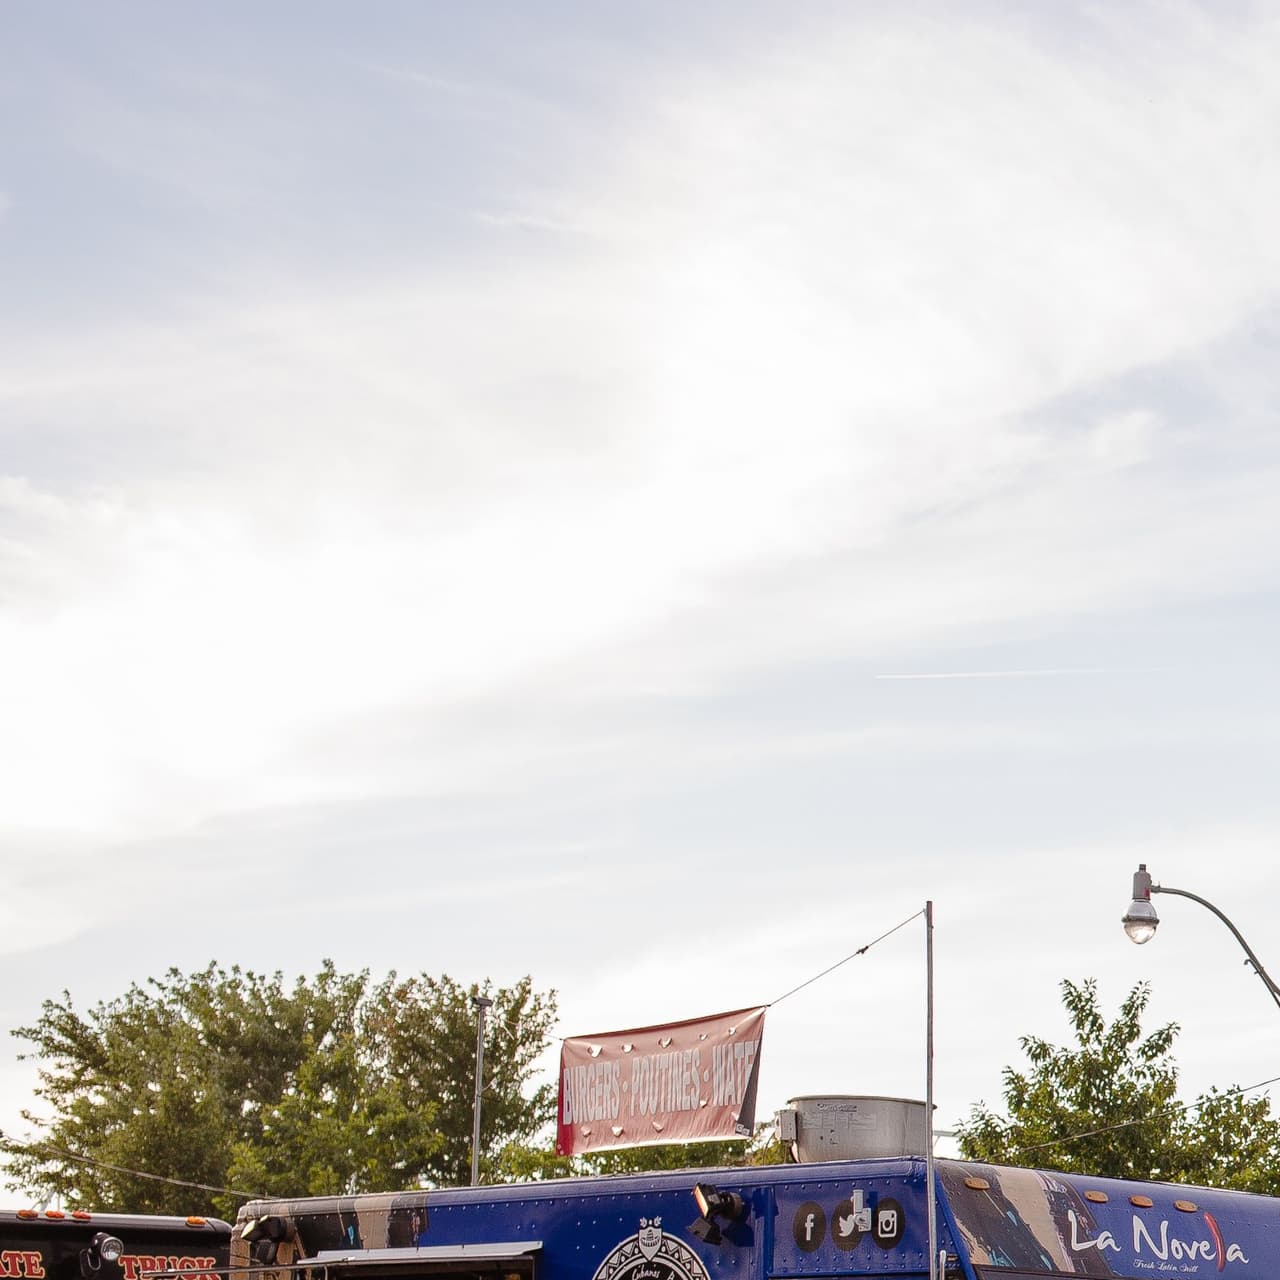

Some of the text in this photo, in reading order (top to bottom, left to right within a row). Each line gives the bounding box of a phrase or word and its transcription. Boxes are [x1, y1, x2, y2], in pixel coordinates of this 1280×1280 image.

[563, 1040, 760, 1125] BURGERS POUTINES WATE
[1067, 1209, 1122, 1252] La
